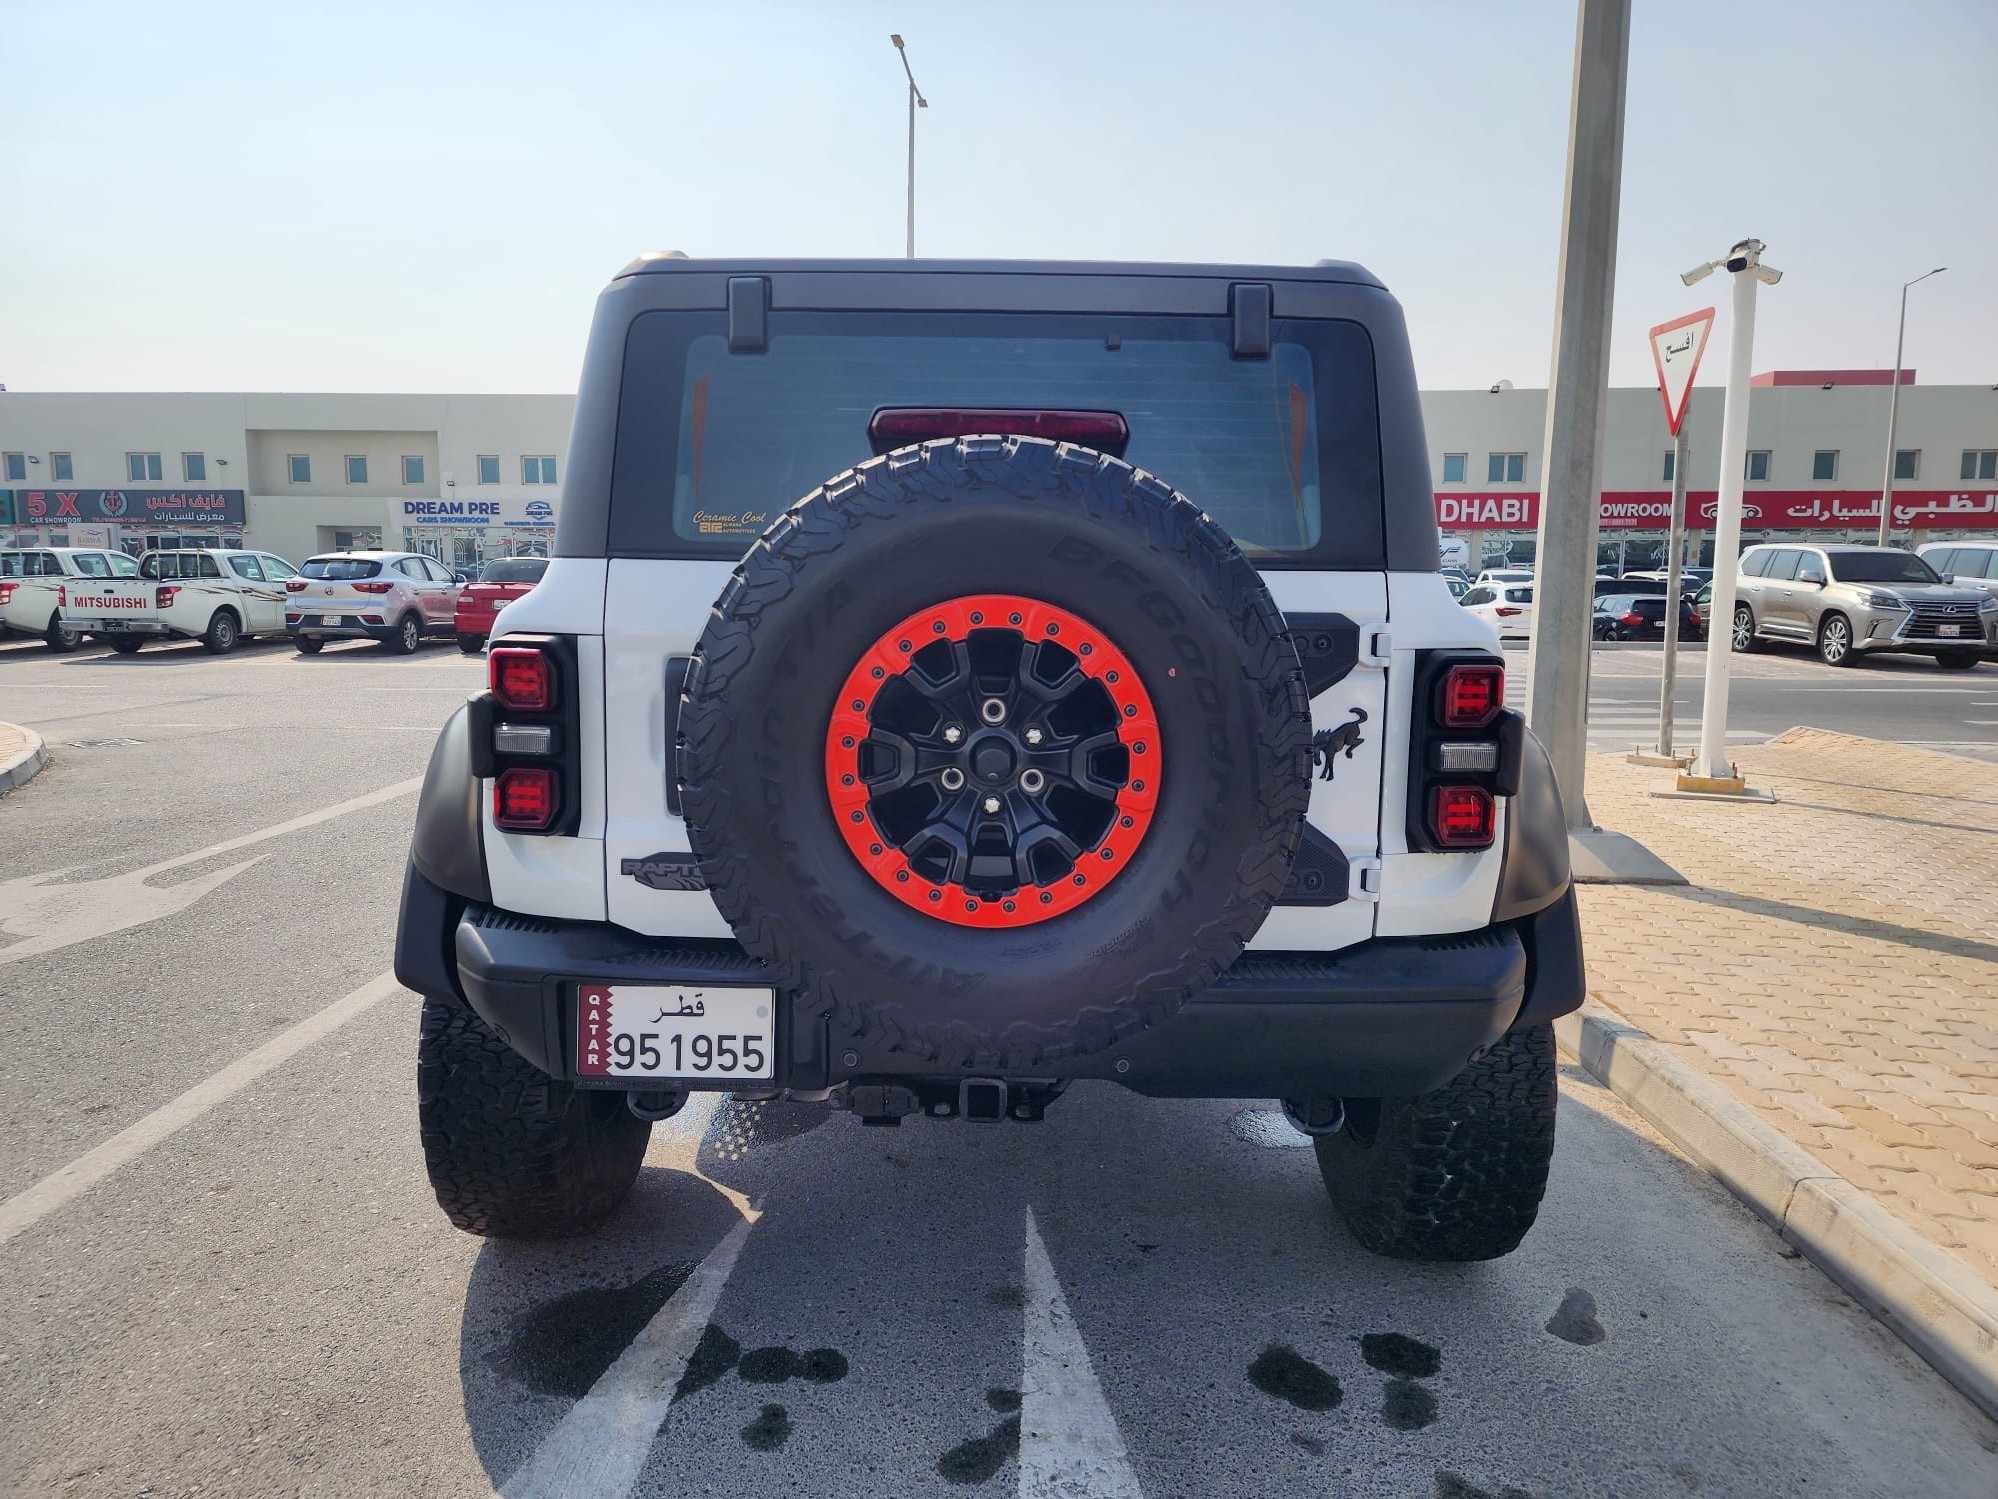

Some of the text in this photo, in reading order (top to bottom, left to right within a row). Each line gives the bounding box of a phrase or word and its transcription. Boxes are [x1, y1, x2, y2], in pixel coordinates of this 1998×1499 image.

[28, 492, 47, 517] 5
[55, 492, 81, 517] X
[404, 501, 501, 515] DREAM PRE
[1440, 499, 1529, 523] DHABI
[154, 512, 195, 522] للسيارات
[196, 513, 225, 522] معرض
[416, 516, 490, 524] CARS SHOWROOM
[693, 510, 767, 524] Ceramic Cool
[74, 596, 147, 609] MITSUBISHI
[649, 993, 705, 1023] قطر
[587, 994, 601, 1065] QATAR
[613, 1033, 764, 1072] 951955
